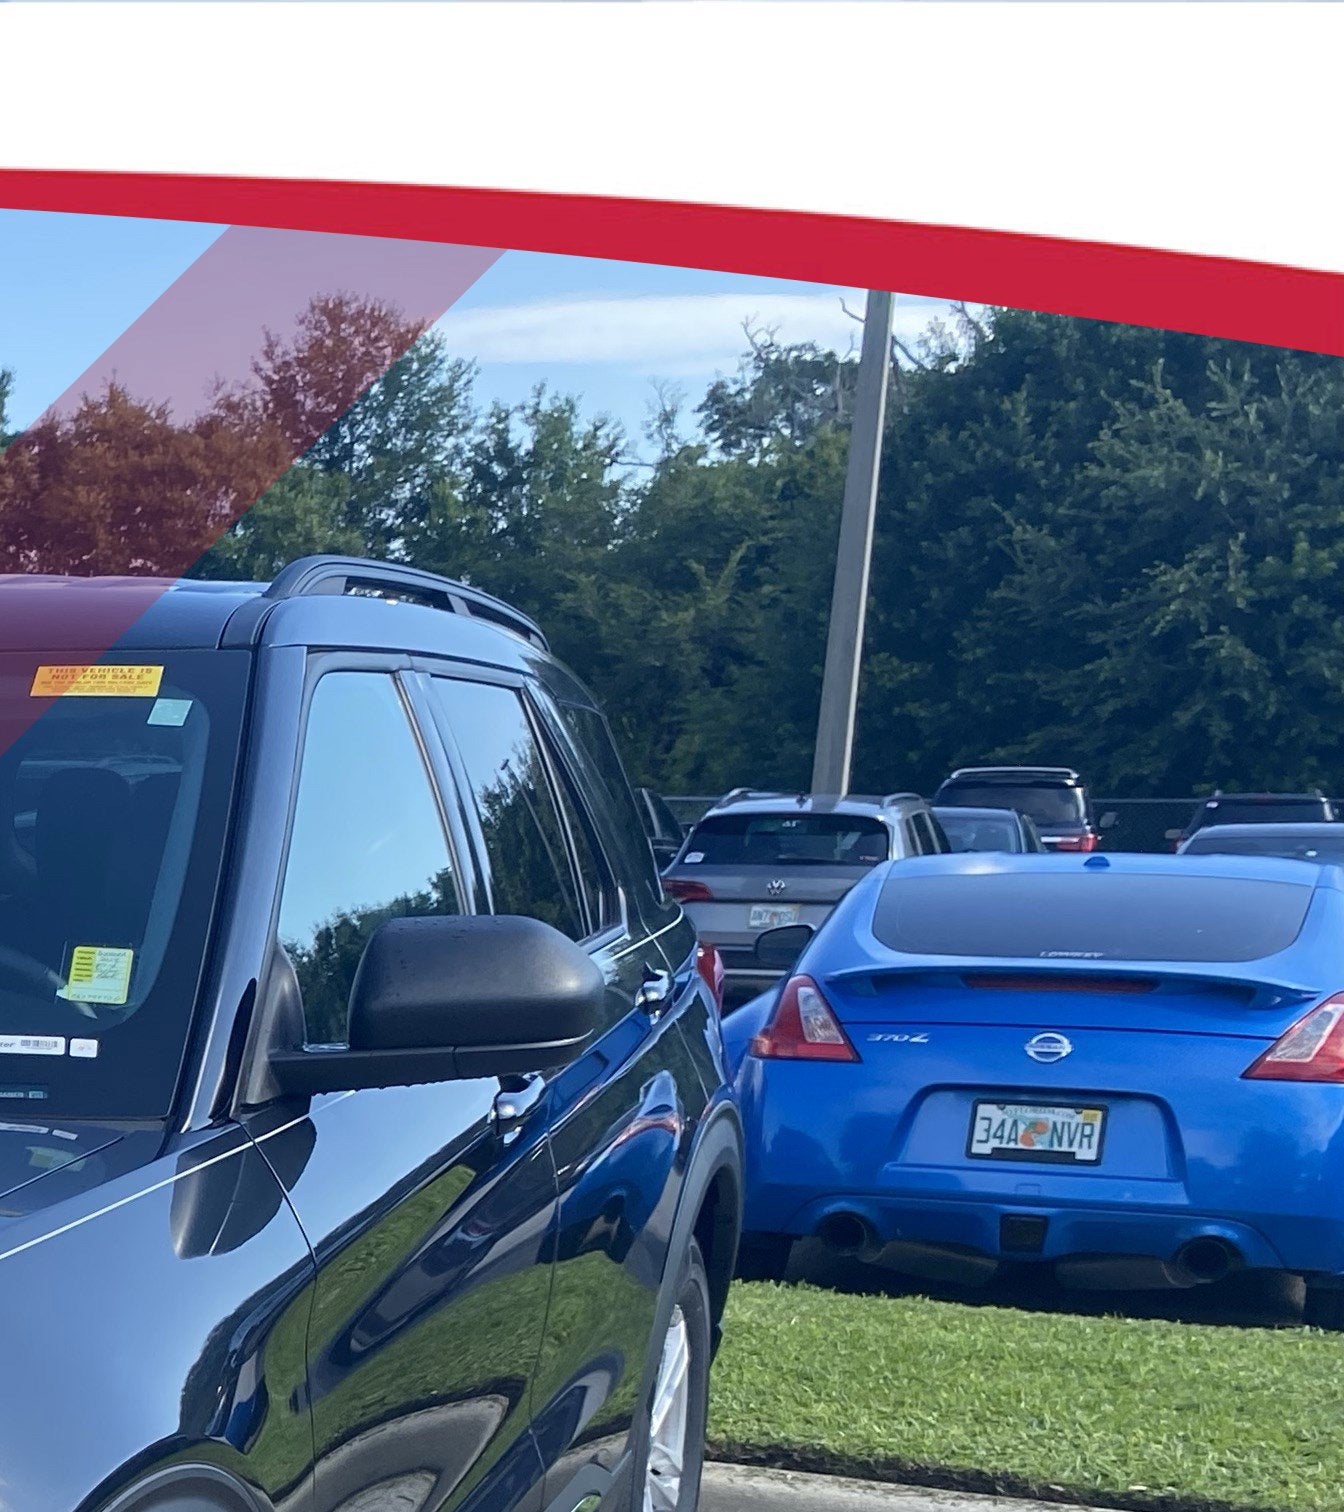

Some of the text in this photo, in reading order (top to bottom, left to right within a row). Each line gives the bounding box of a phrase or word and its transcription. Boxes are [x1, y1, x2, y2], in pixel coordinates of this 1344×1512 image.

[866, 1031, 931, 1043] 370Z
[975, 1116, 1096, 1149] 34A NVR
